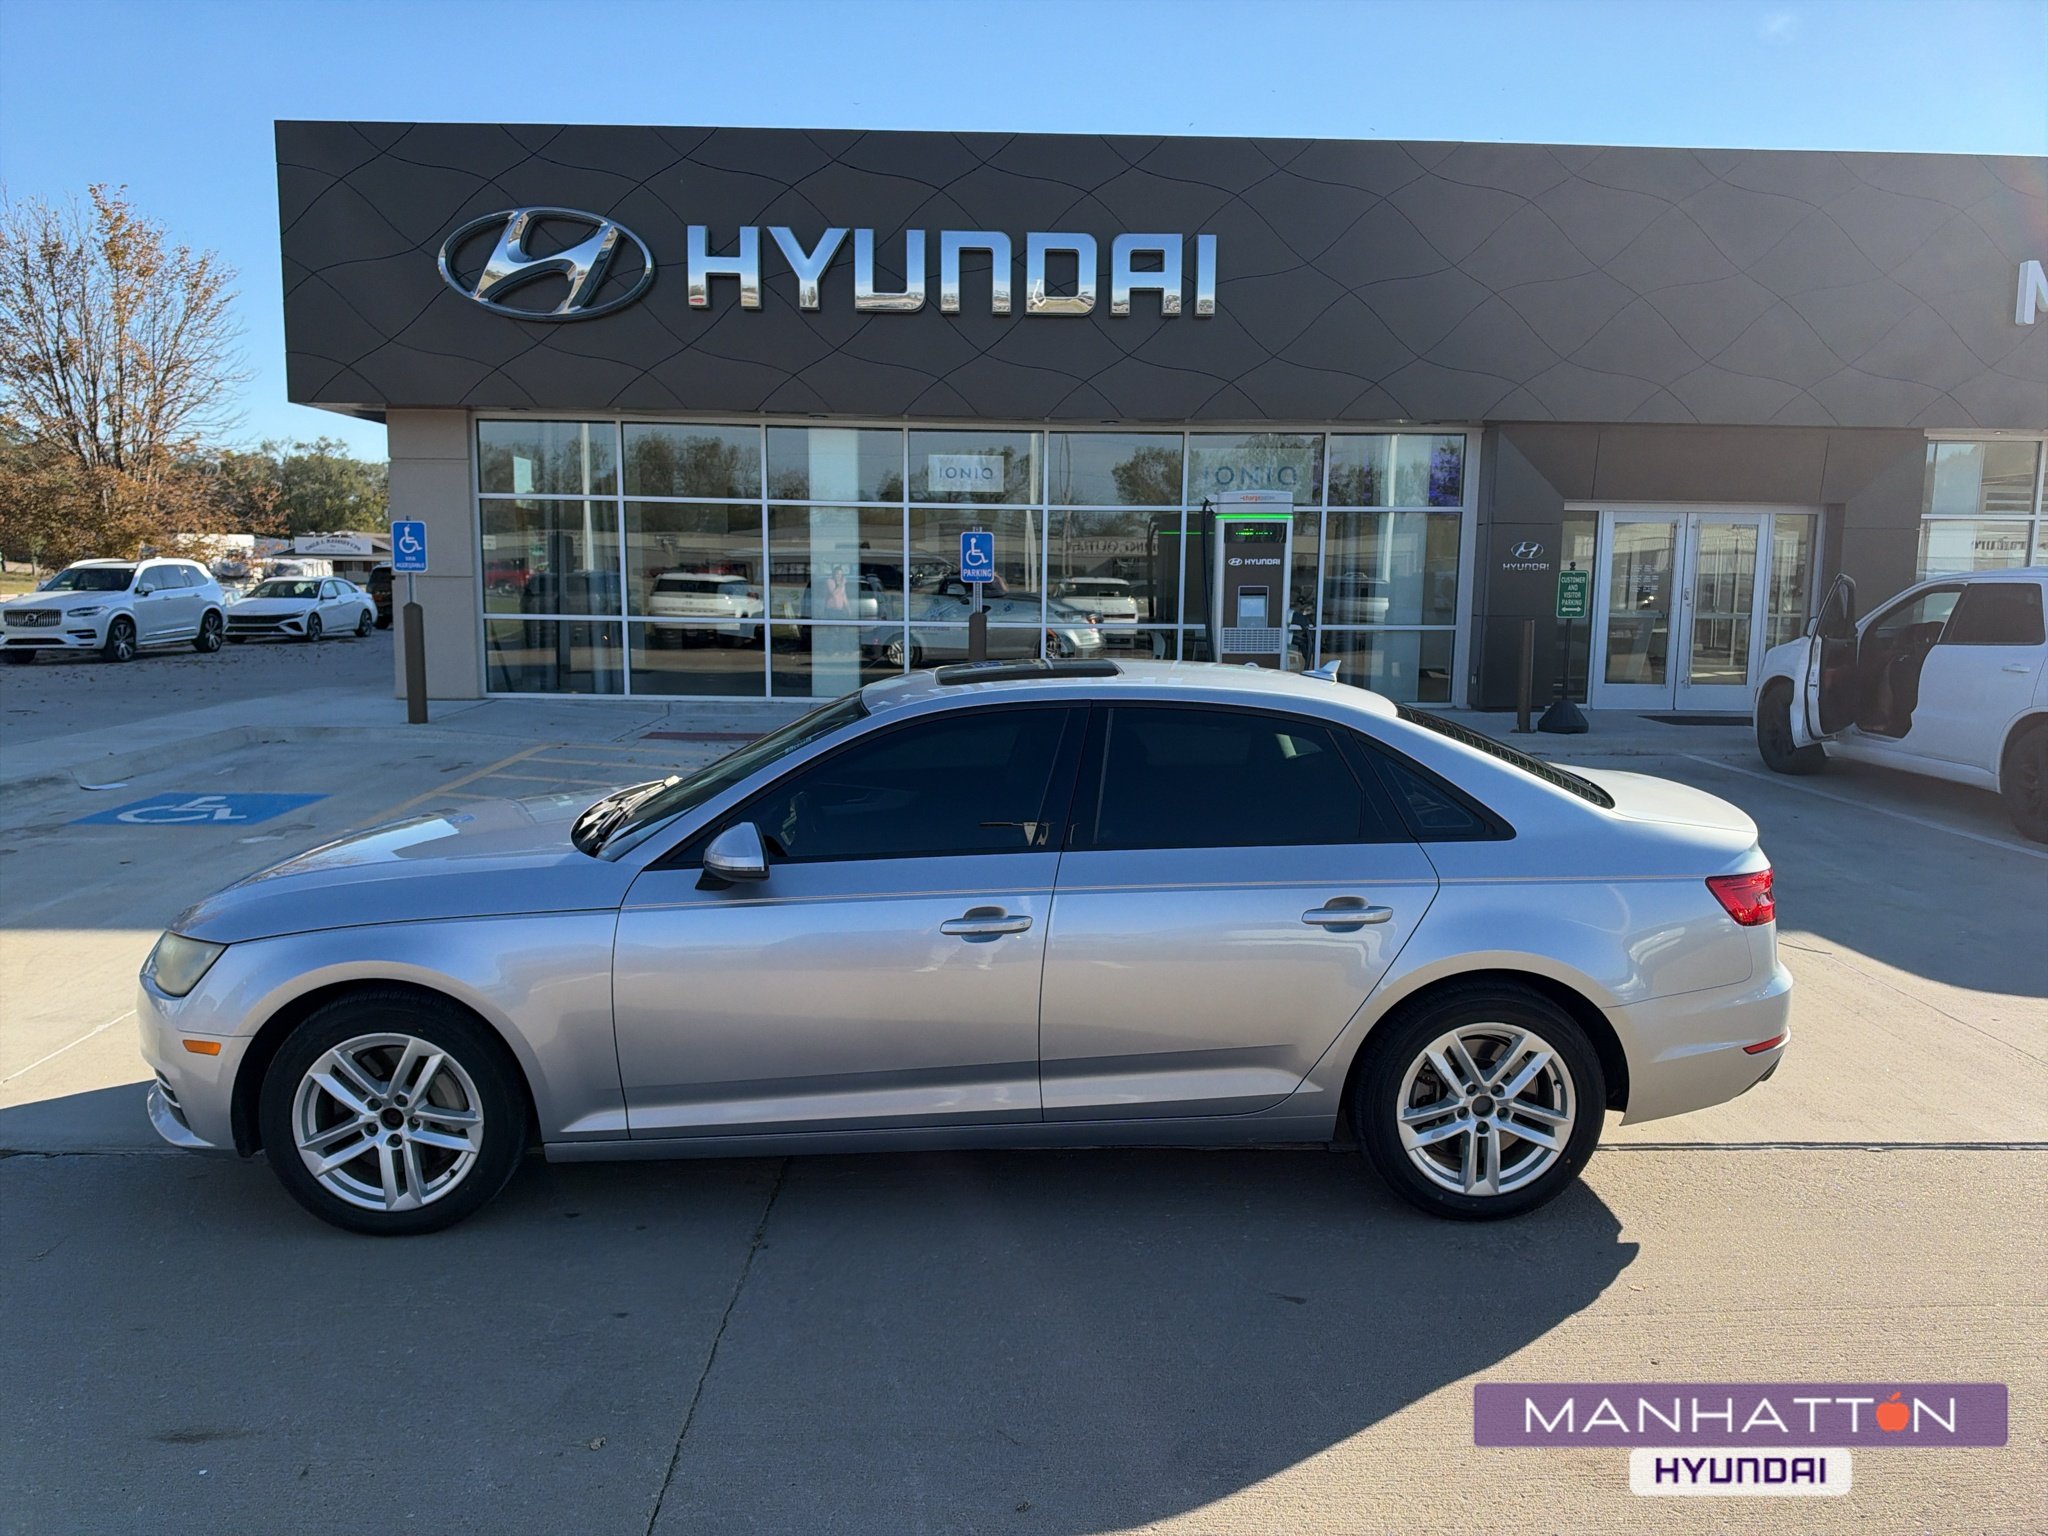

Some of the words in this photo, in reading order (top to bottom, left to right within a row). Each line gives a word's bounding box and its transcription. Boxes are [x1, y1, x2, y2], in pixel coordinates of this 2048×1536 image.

[687, 224, 1218, 317] HYUNDAI
[939, 466, 993, 480] IONIQ
[1243, 558, 1281, 566] HYUNDAI
[1502, 562, 1550, 571] HYUNDAI
[963, 568, 992, 577] PARKING
[1560, 576, 1586, 584] CUSTOMER
[1563, 591, 1582, 599] VISITOR
